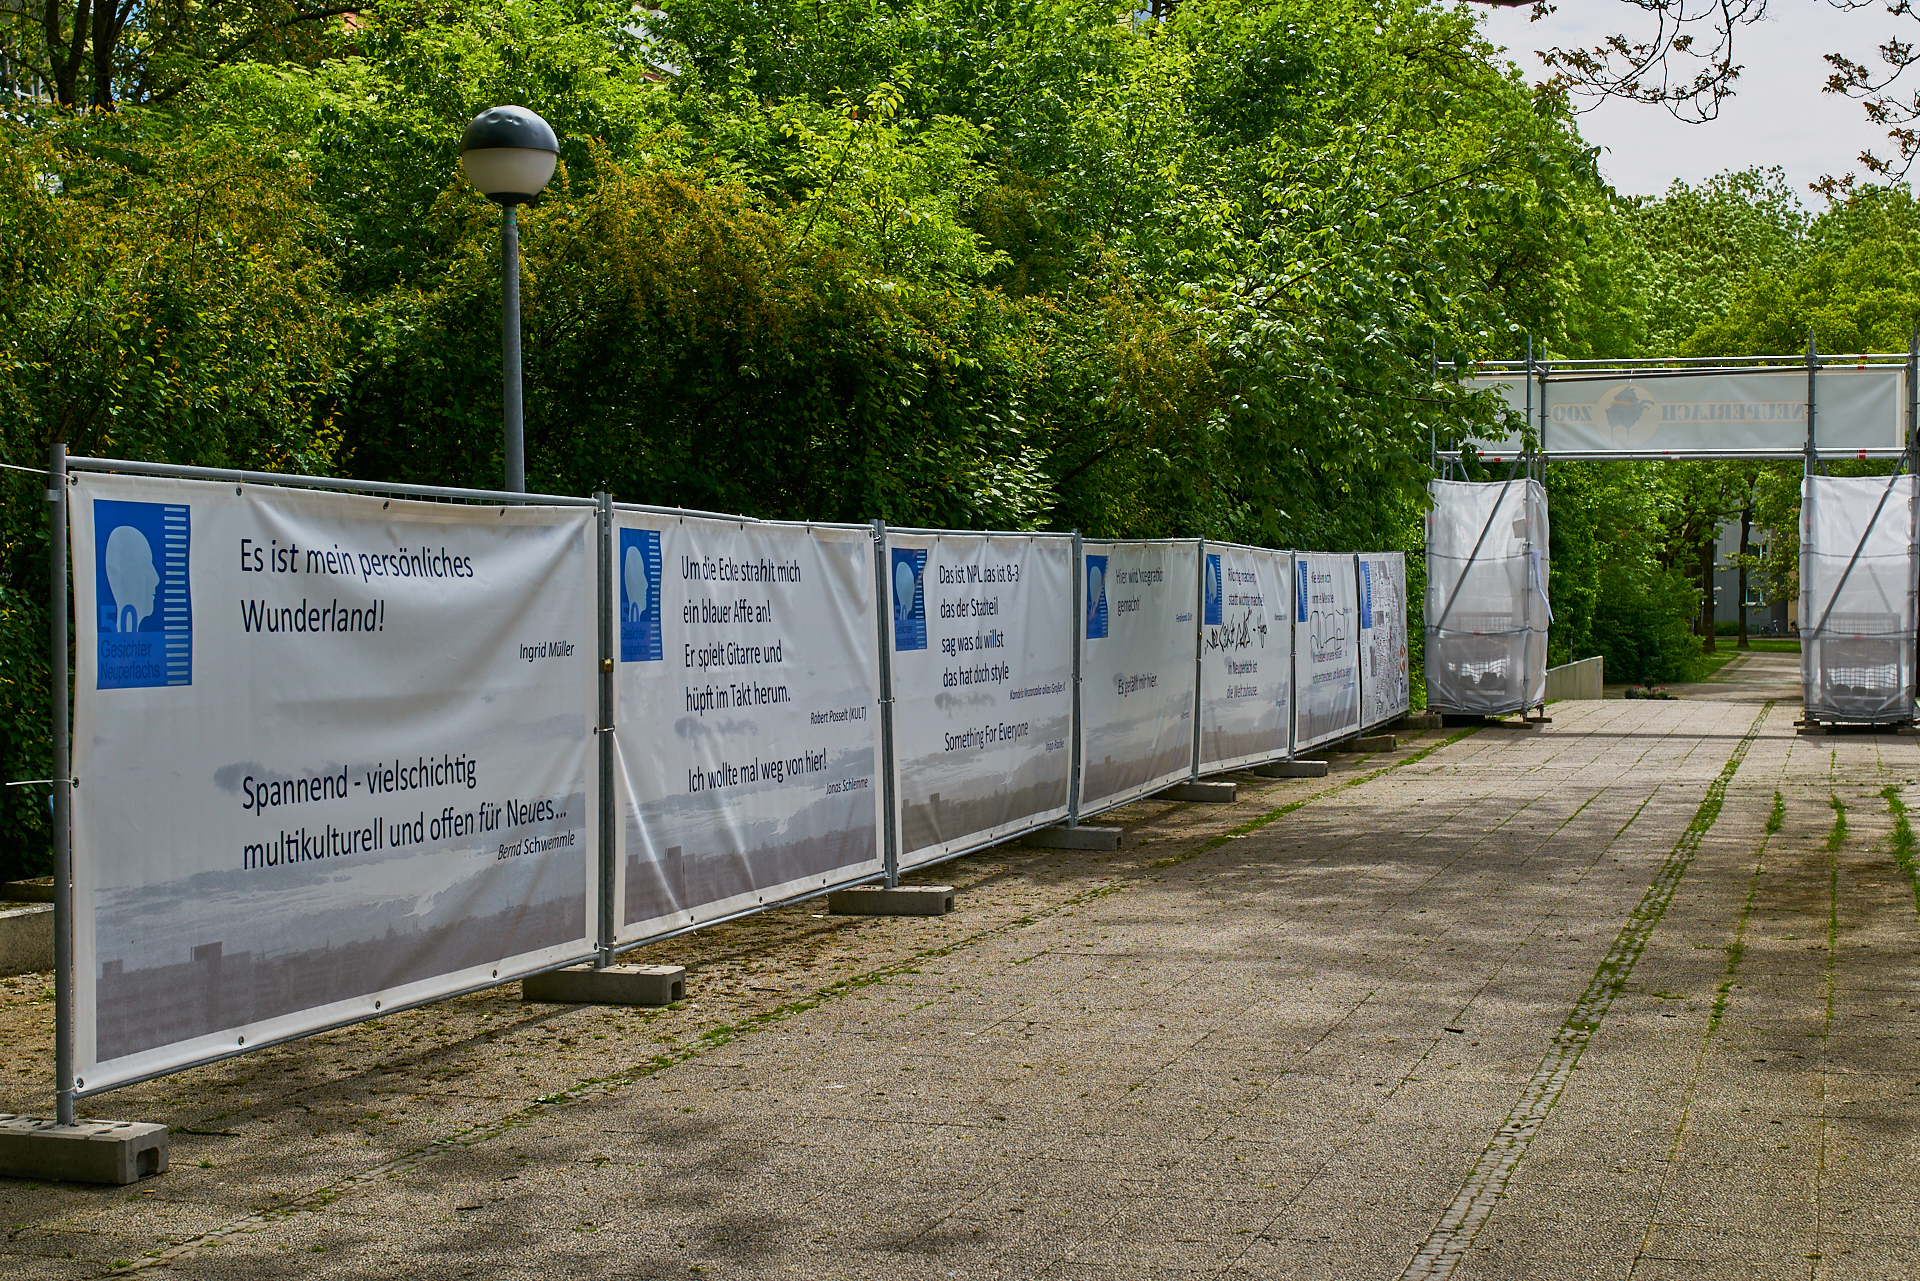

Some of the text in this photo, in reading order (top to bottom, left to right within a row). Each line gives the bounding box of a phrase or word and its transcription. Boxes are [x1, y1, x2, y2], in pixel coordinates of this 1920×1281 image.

[241, 538, 474, 583] Es ist mein persönliches
[682, 555, 801, 583] Um die Ecke strahlt mich
[939, 565, 955, 584] Das
[955, 565, 966, 584] ist
[997, 564, 1006, 583] ist
[1007, 565, 1019, 582] 8-3
[1116, 568, 1127, 584] Hier
[1128, 568, 1138, 584] wird
[101, 604, 138, 632] 50
[241, 598, 385, 633] Wunderland!
[683, 599, 771, 624] ein blauer Affe an!
[940, 599, 955, 619] das
[957, 598, 969, 617] der
[101, 640, 152, 658] Gesichter
[519, 641, 574, 661] Ingrid Müller
[685, 640, 783, 673] Er spielt Gitarre und
[942, 637, 956, 657] sag
[958, 637, 973, 651] was
[984, 629, 1004, 649] willst
[101, 661, 160, 684] Neuperlachs
[943, 667, 957, 687] das
[959, 665, 973, 685] hat
[991, 660, 1009, 684] style
[1118, 678, 1124, 695] Es
[686, 682, 791, 716] hüpft im Takt herum.
[810, 706, 867, 725] Robert Posselt (KULT)
[945, 721, 1028, 752] Something For Everyone
[689, 748, 827, 792] Ich wollte mal weg von hier!
[242, 764, 348, 817] Spannend
[366, 753, 476, 797] vielschichtig
[826, 777, 868, 795] Jonas Schlemme
[243, 799, 567, 870] multikulturell und offen für Neues...
[497, 830, 574, 861] Bernd Schwemmle
